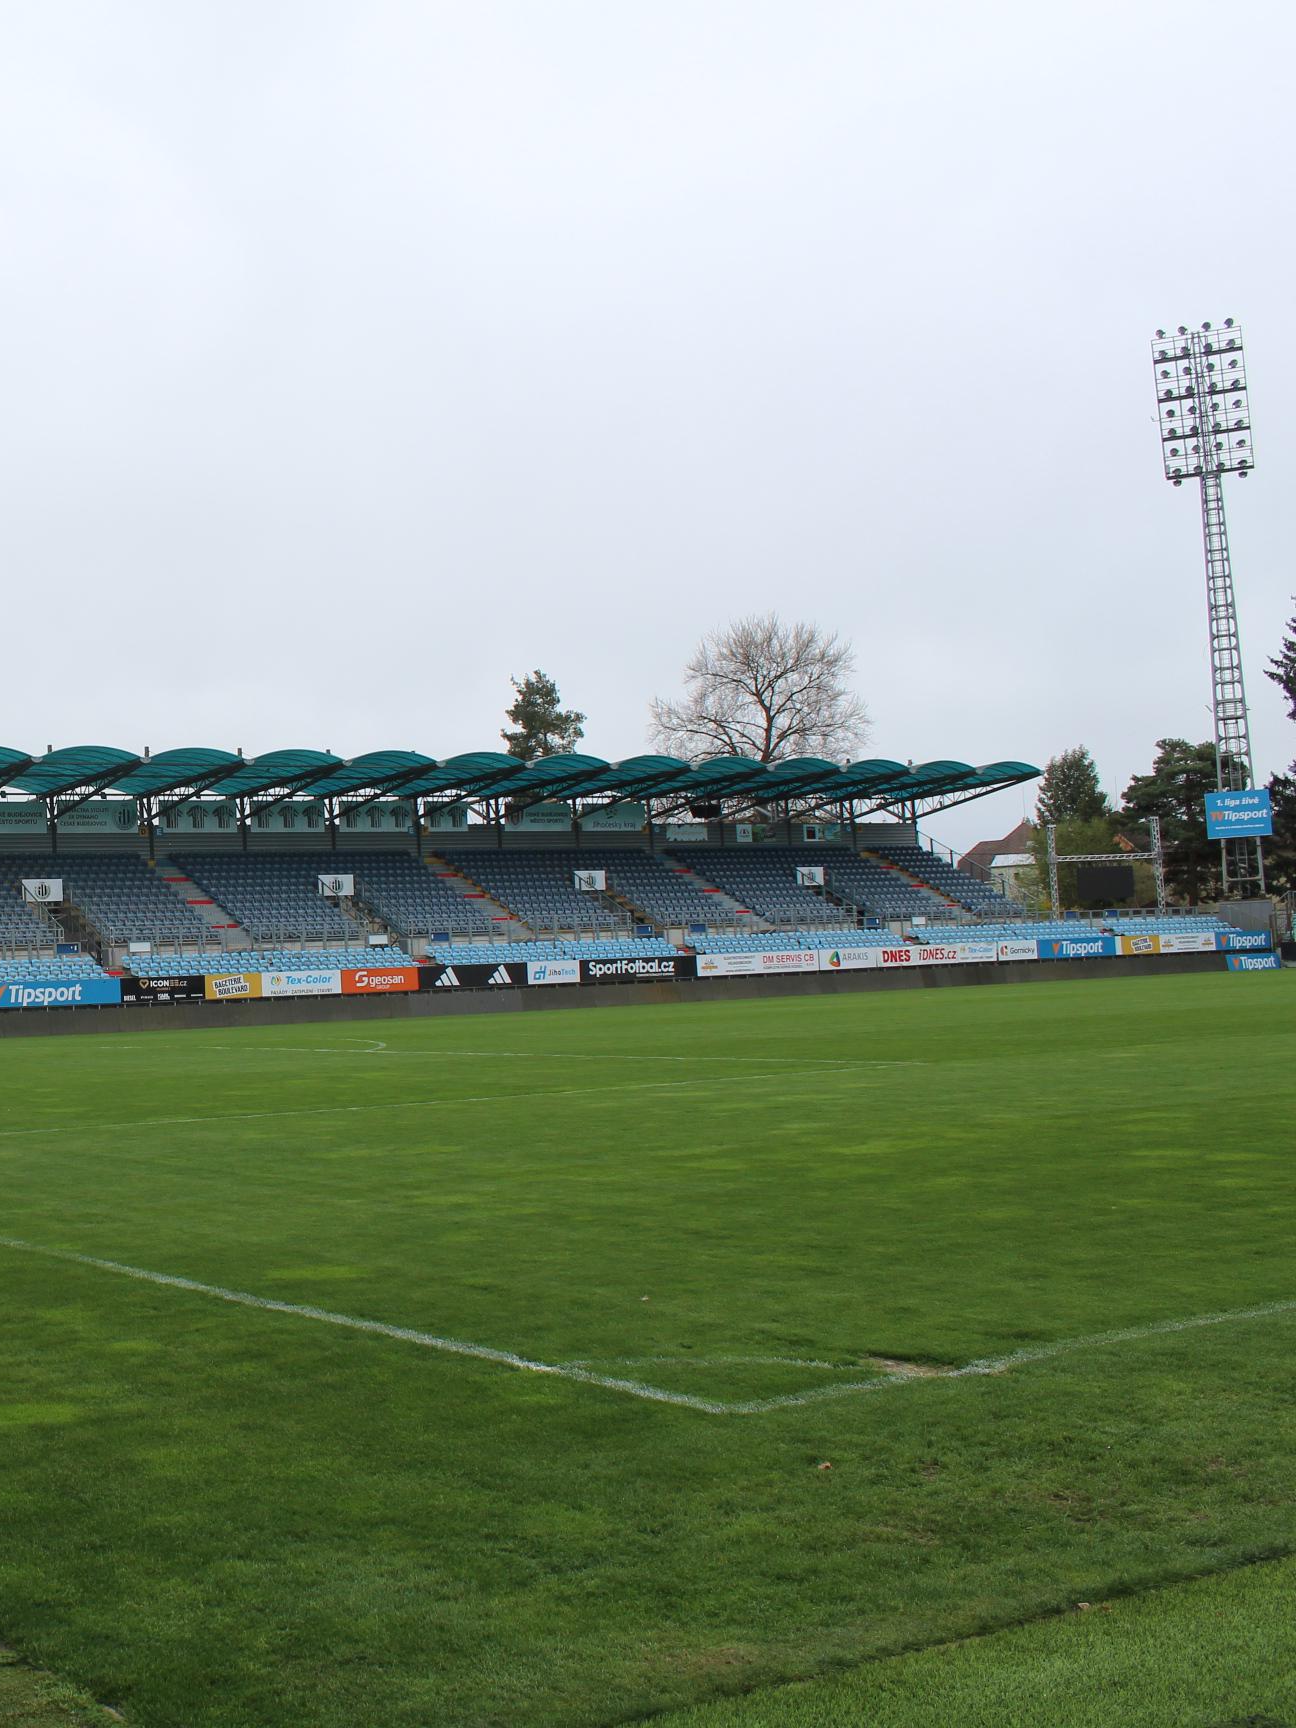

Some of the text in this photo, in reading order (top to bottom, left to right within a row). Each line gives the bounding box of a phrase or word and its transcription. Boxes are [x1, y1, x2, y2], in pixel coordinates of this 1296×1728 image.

[1225, 797, 1240, 807] liga
[1228, 931, 1266, 950] Tipsport
[918, 948, 957, 961] iDNES.cz
[1060, 939, 1104, 957] Tipsport
[762, 955, 774, 964] DM
[775, 954, 802, 963] SERVIS
[803, 953, 815, 962] CB
[842, 951, 869, 961] ARAKIS
[882, 949, 911, 963] DNES
[1239, 954, 1276, 971] Tipsport
[547, 968, 576, 977] JihoTech
[588, 958, 675, 977] SportFotbal.cz
[285, 974, 333, 986] Tex-Color
[369, 975, 405, 988] geosan
[8, 983, 82, 1006] Tipsport
[217, 984, 249, 996] BOULEVARD
